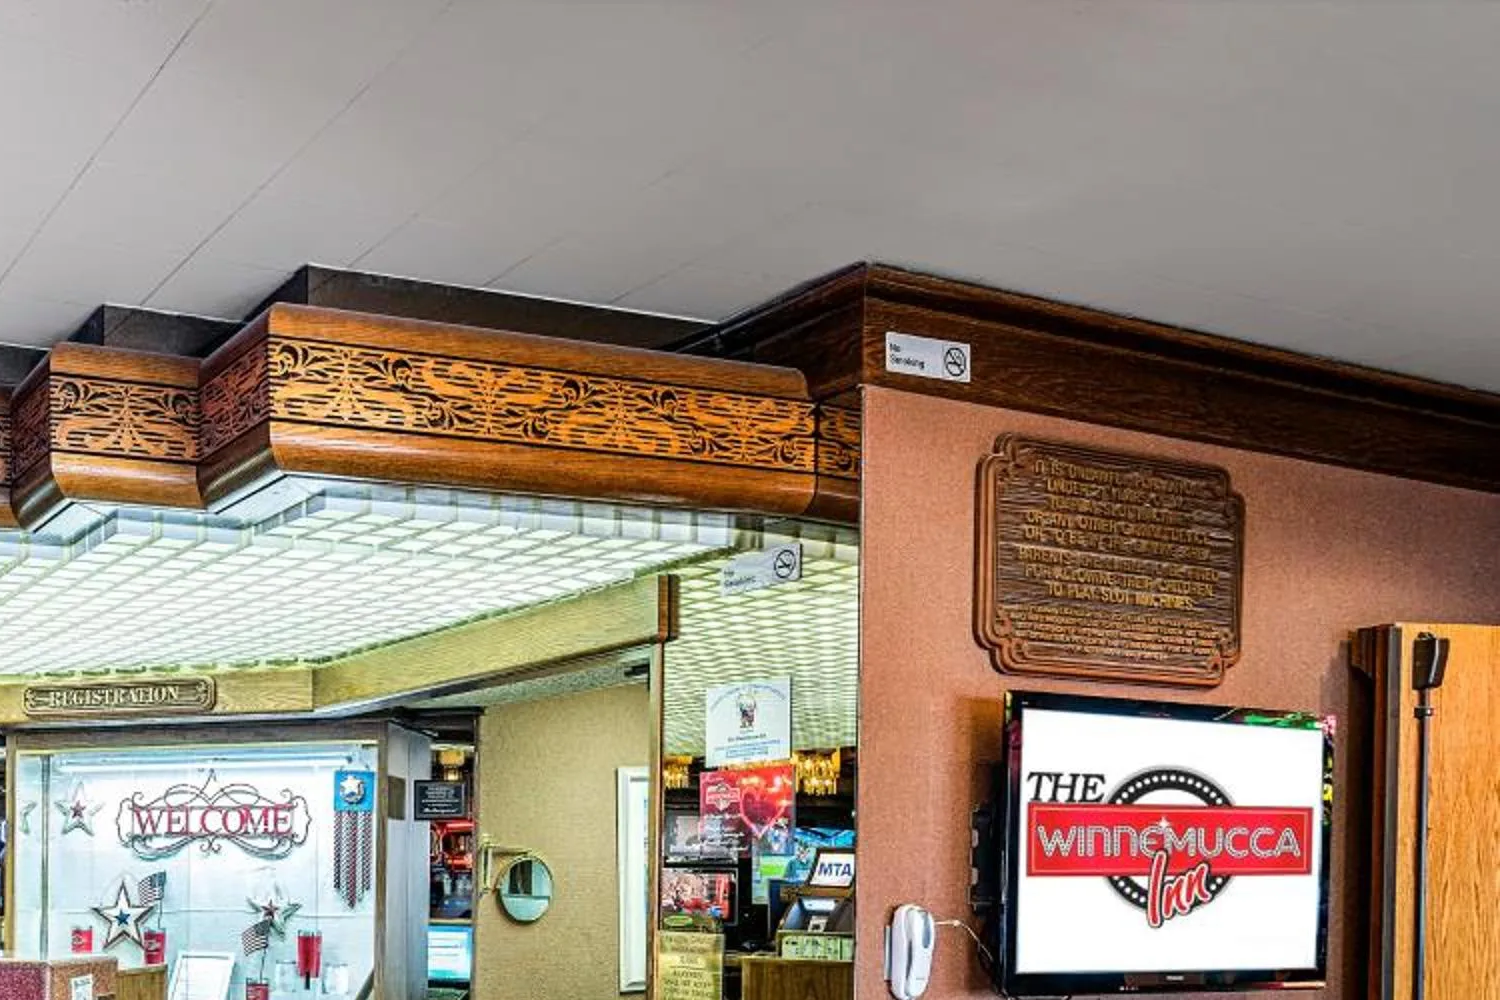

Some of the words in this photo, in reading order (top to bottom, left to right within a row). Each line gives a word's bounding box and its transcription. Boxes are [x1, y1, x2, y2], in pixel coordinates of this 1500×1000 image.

[49, 685, 181, 709] REGISTRATION
[1026, 770, 1107, 804] THE
[133, 803, 294, 836] WELCOME
[1036, 824, 1302, 858] WINNEMUCCA
[1146, 848, 1213, 929] Inn
